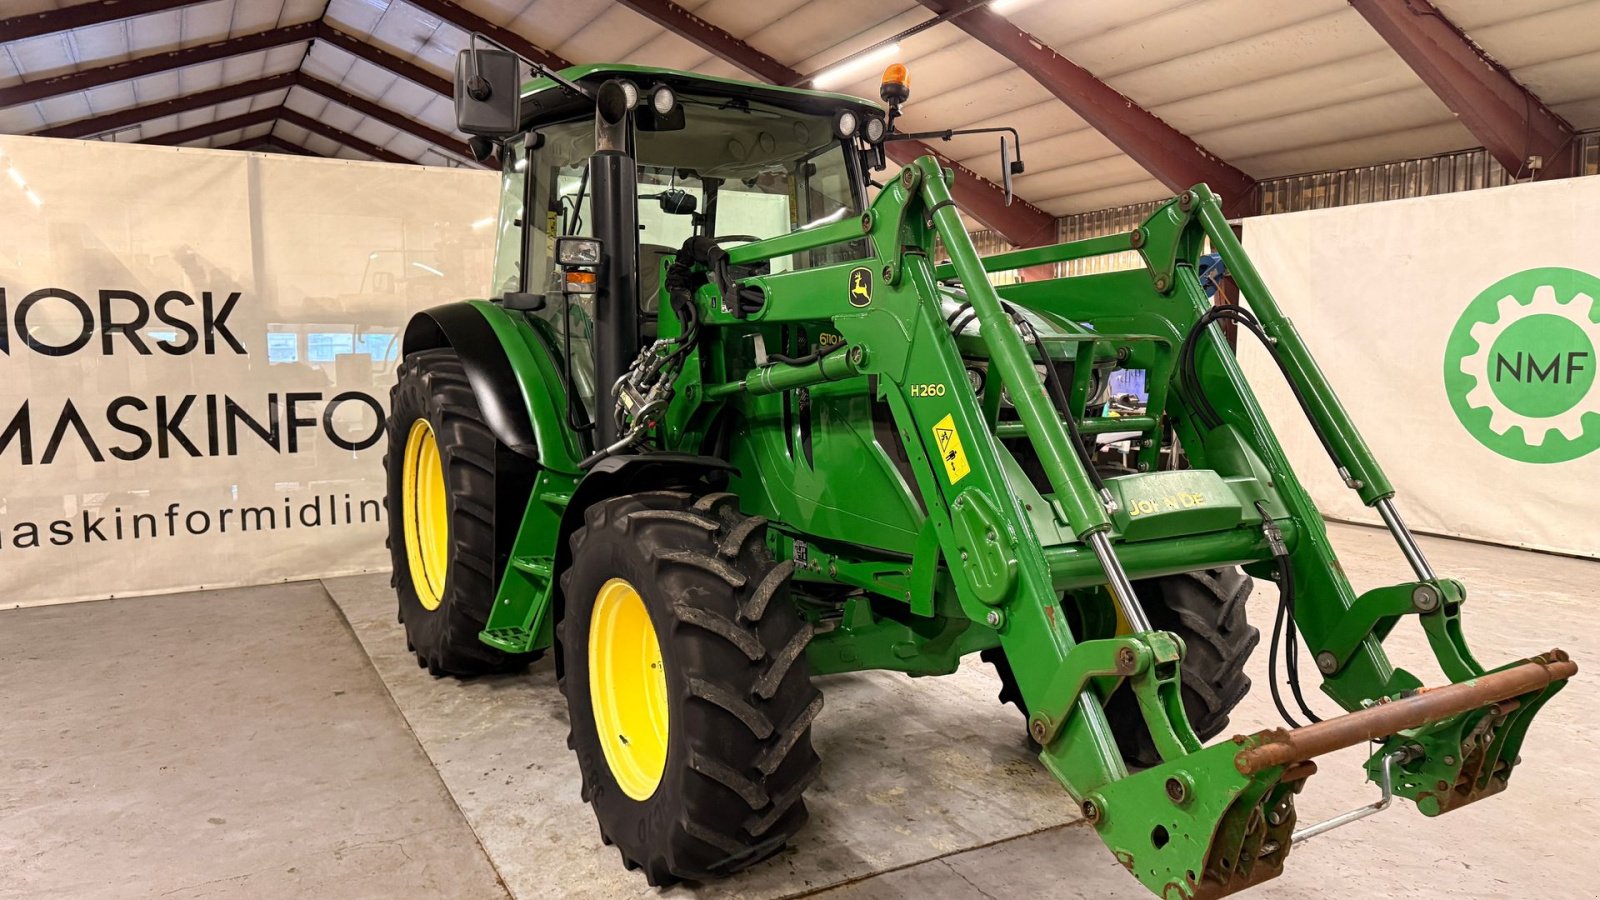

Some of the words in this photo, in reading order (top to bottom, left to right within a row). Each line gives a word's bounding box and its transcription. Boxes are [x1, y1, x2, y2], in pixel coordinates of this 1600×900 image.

[0, 287, 248, 357] ORSK
[1496, 351, 1588, 384] NMF
[911, 383, 946, 397] H260
[0, 494, 380, 549] askinformidlin
